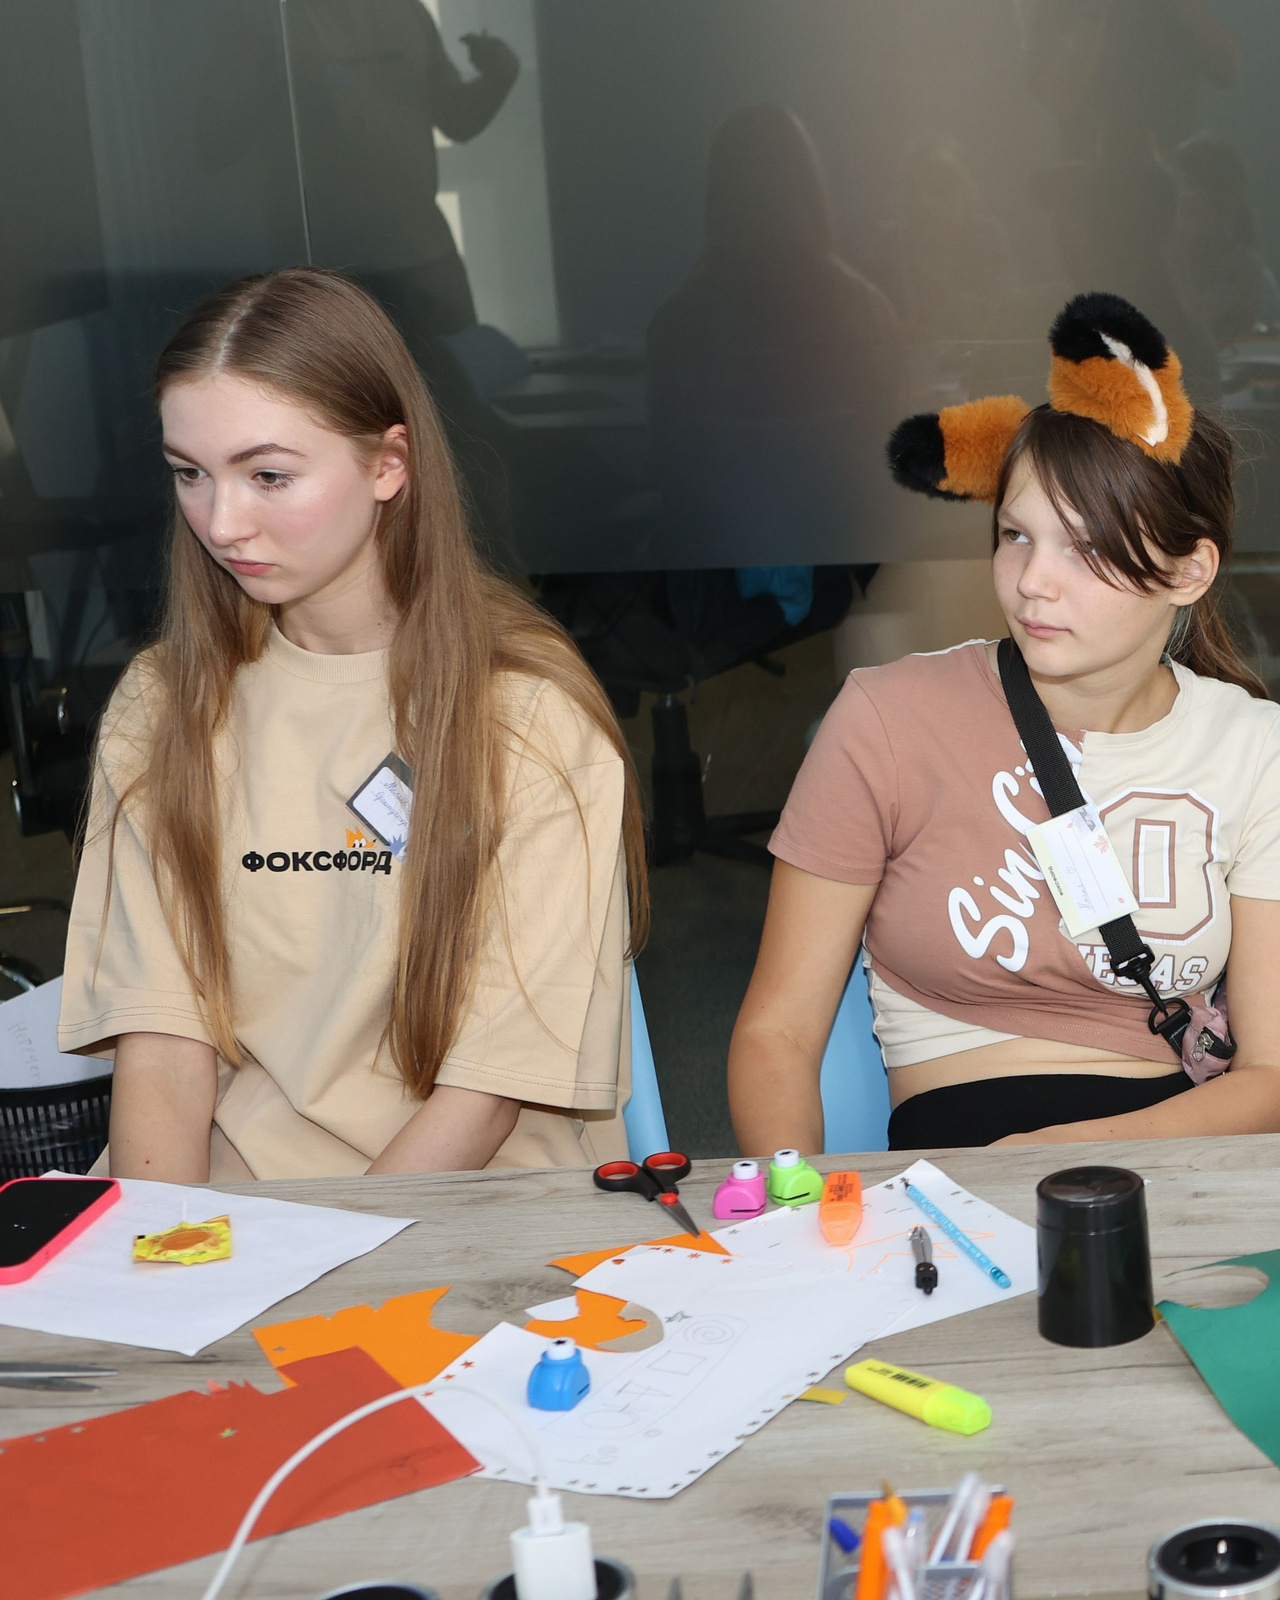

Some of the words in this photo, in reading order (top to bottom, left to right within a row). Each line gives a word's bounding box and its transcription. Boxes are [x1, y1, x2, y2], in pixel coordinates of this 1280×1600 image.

[241, 850, 392, 875] ФОКСФОРД
[1047, 865, 1064, 896] ФОКСФОРД
[1077, 943, 1209, 991] EAS
